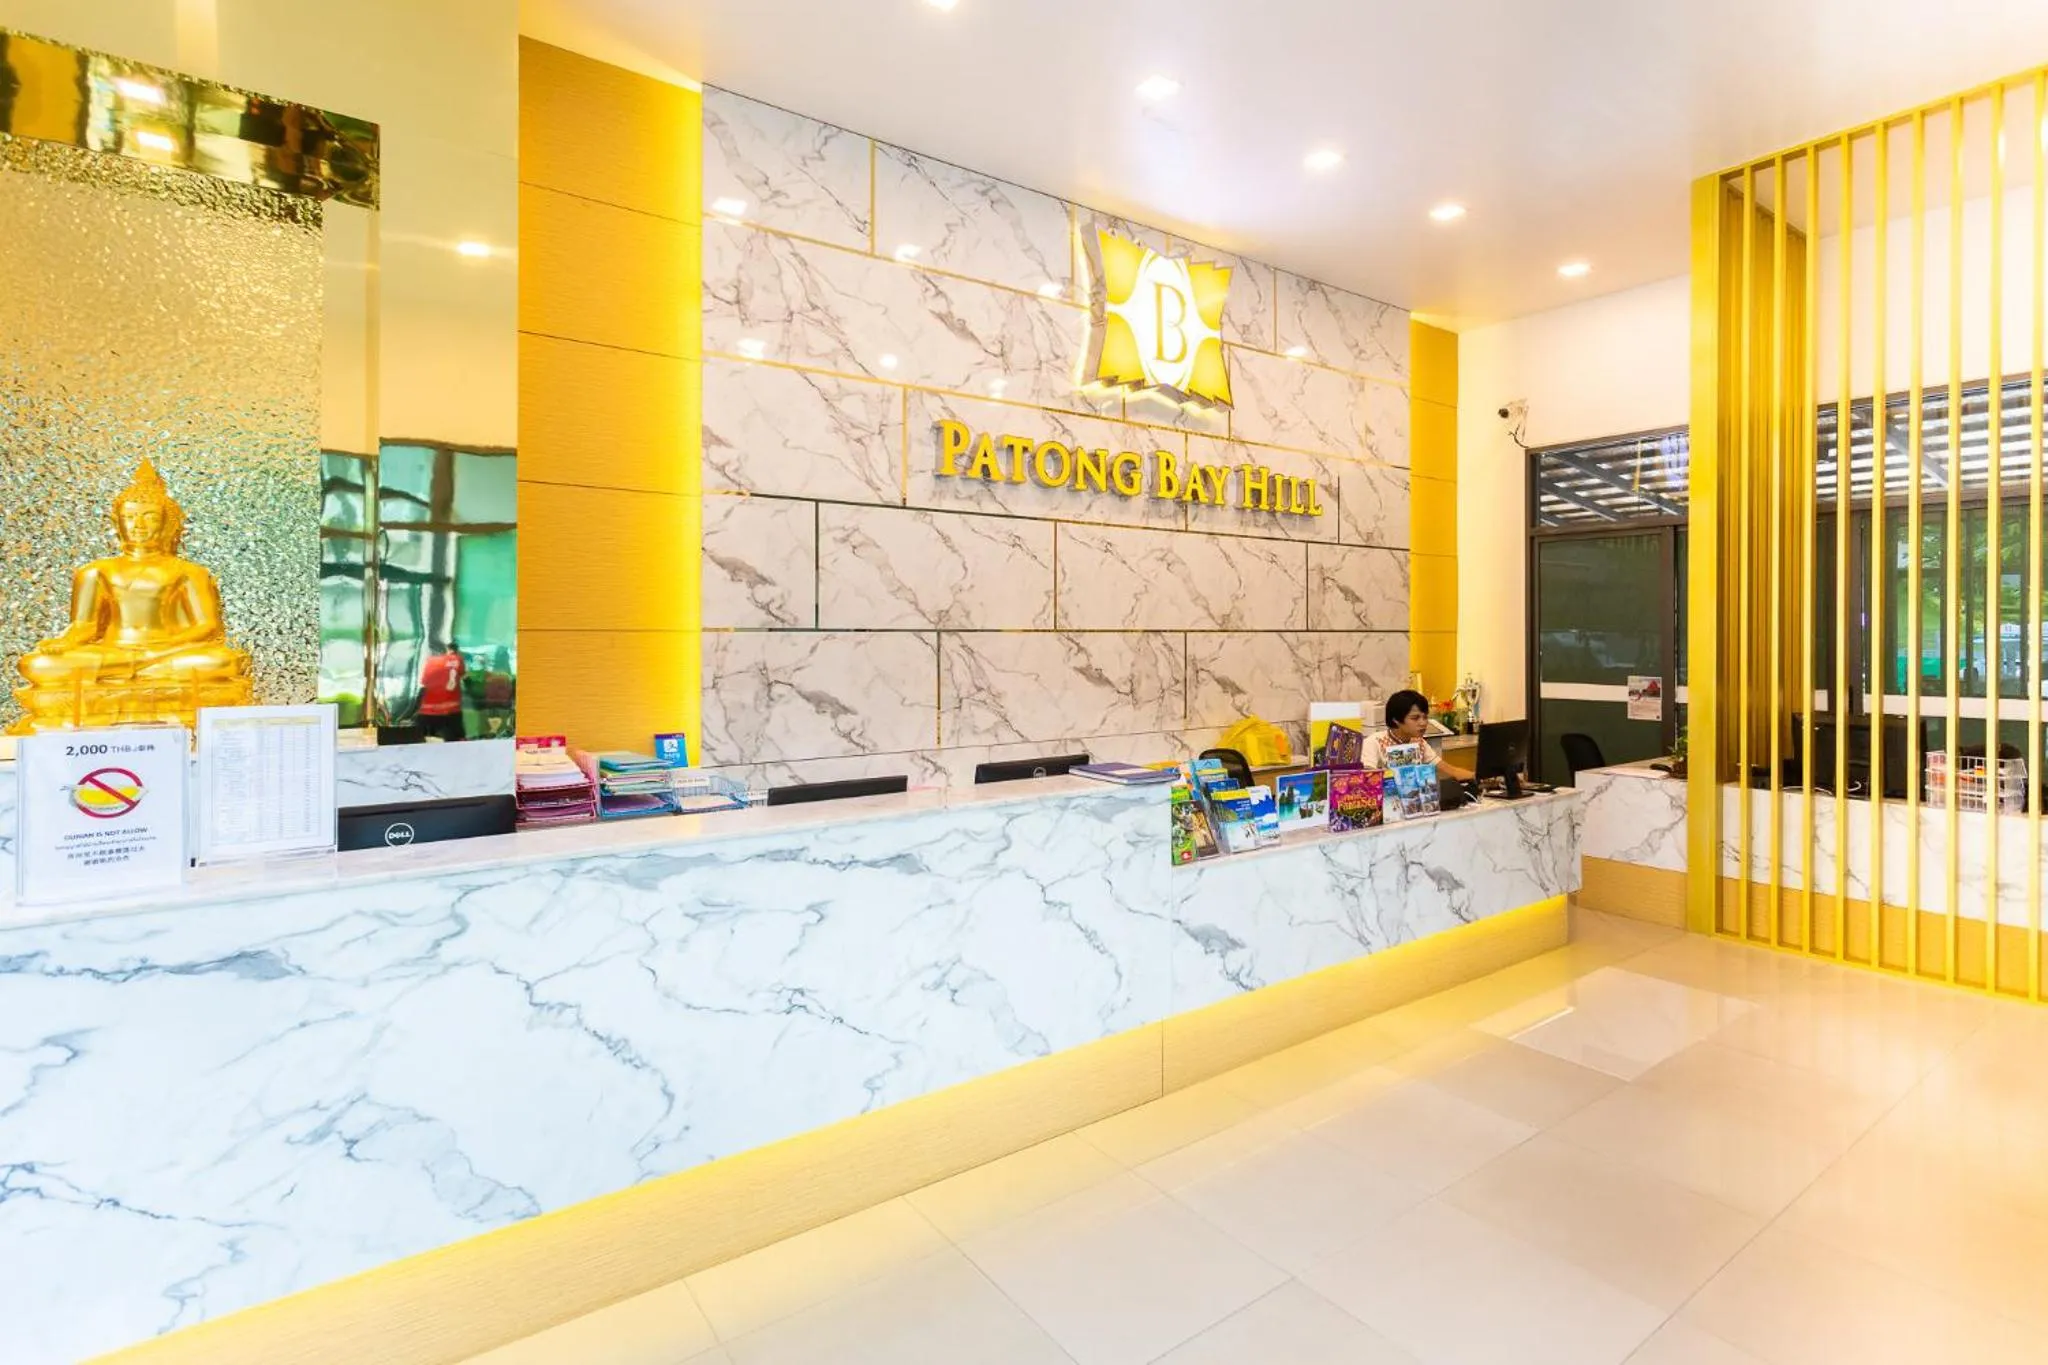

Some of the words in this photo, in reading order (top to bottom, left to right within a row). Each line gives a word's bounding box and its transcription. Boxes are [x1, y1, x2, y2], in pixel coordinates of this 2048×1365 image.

[1153, 281, 1188, 364] B
[937, 418, 1143, 497] PATONG
[1154, 450, 1231, 506] BAY
[1239, 463, 1323, 517] HILL
[66, 744, 108, 756] 2,000
[104, 829, 121, 837] NOT
[122, 826, 148, 835] ALLOW
[388, 831, 411, 840] DELL
